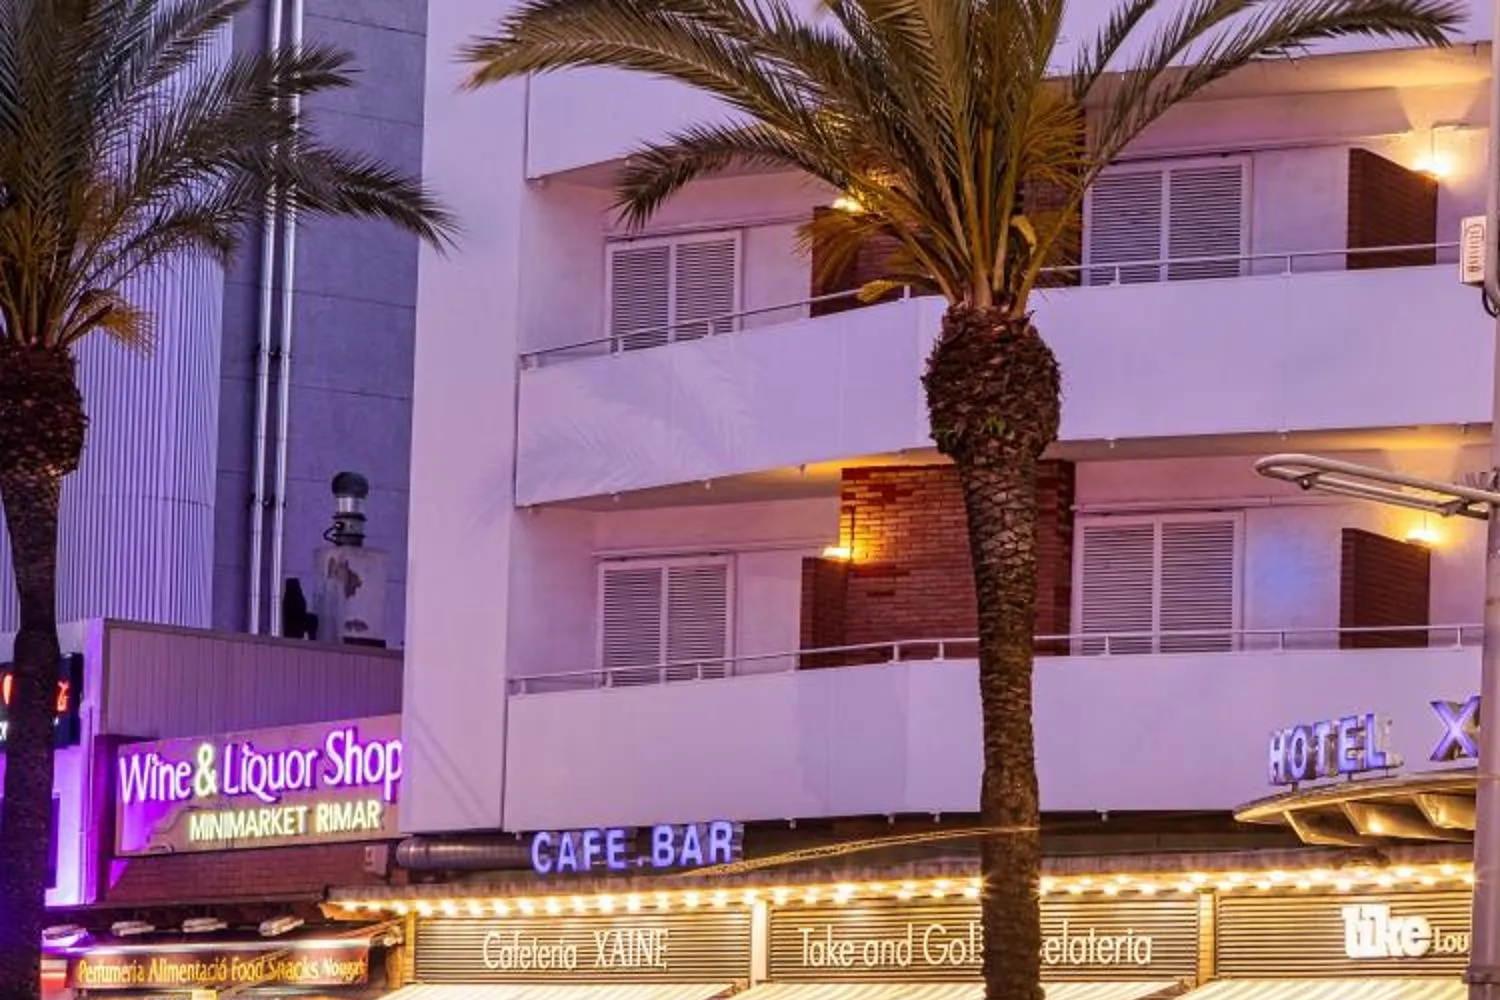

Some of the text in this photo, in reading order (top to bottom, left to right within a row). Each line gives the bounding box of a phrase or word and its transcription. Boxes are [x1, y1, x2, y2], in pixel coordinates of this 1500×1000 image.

[120, 728, 402, 803] Wine & Liquor Shop
[1269, 713, 1389, 785] HOTEL
[189, 799, 381, 841] MINIMARKET RIMAR
[531, 821, 735, 874] CAFE BAR
[482, 927, 669, 970] Cafeteria XAINE
[799, 927, 855, 967] Take
[863, 923, 913, 966] and
[1043, 920, 1153, 965] elateria
[231, 956, 264, 981] Food
